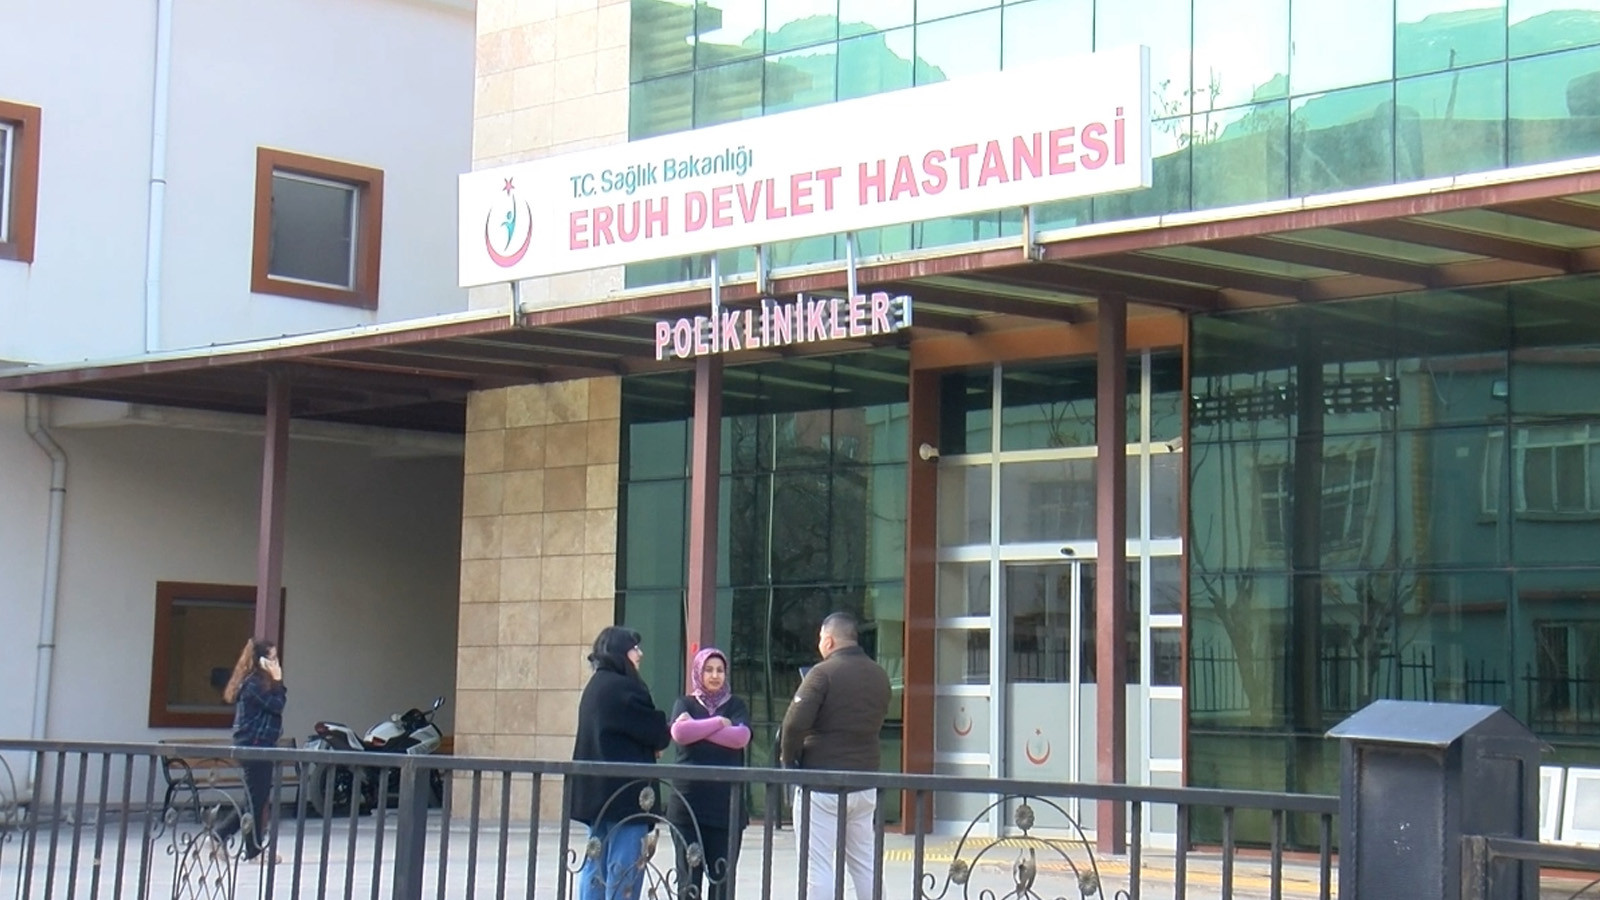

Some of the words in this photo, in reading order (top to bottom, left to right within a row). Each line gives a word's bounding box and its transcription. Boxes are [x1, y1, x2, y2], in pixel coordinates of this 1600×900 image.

[569, 199, 669, 250] ERUH
[684, 167, 842, 233] DEVLET
[858, 106, 1126, 206] HASTANESİ
[600, 163, 658, 196] Sağlık
[663, 145, 753, 183] Bakanlığı
